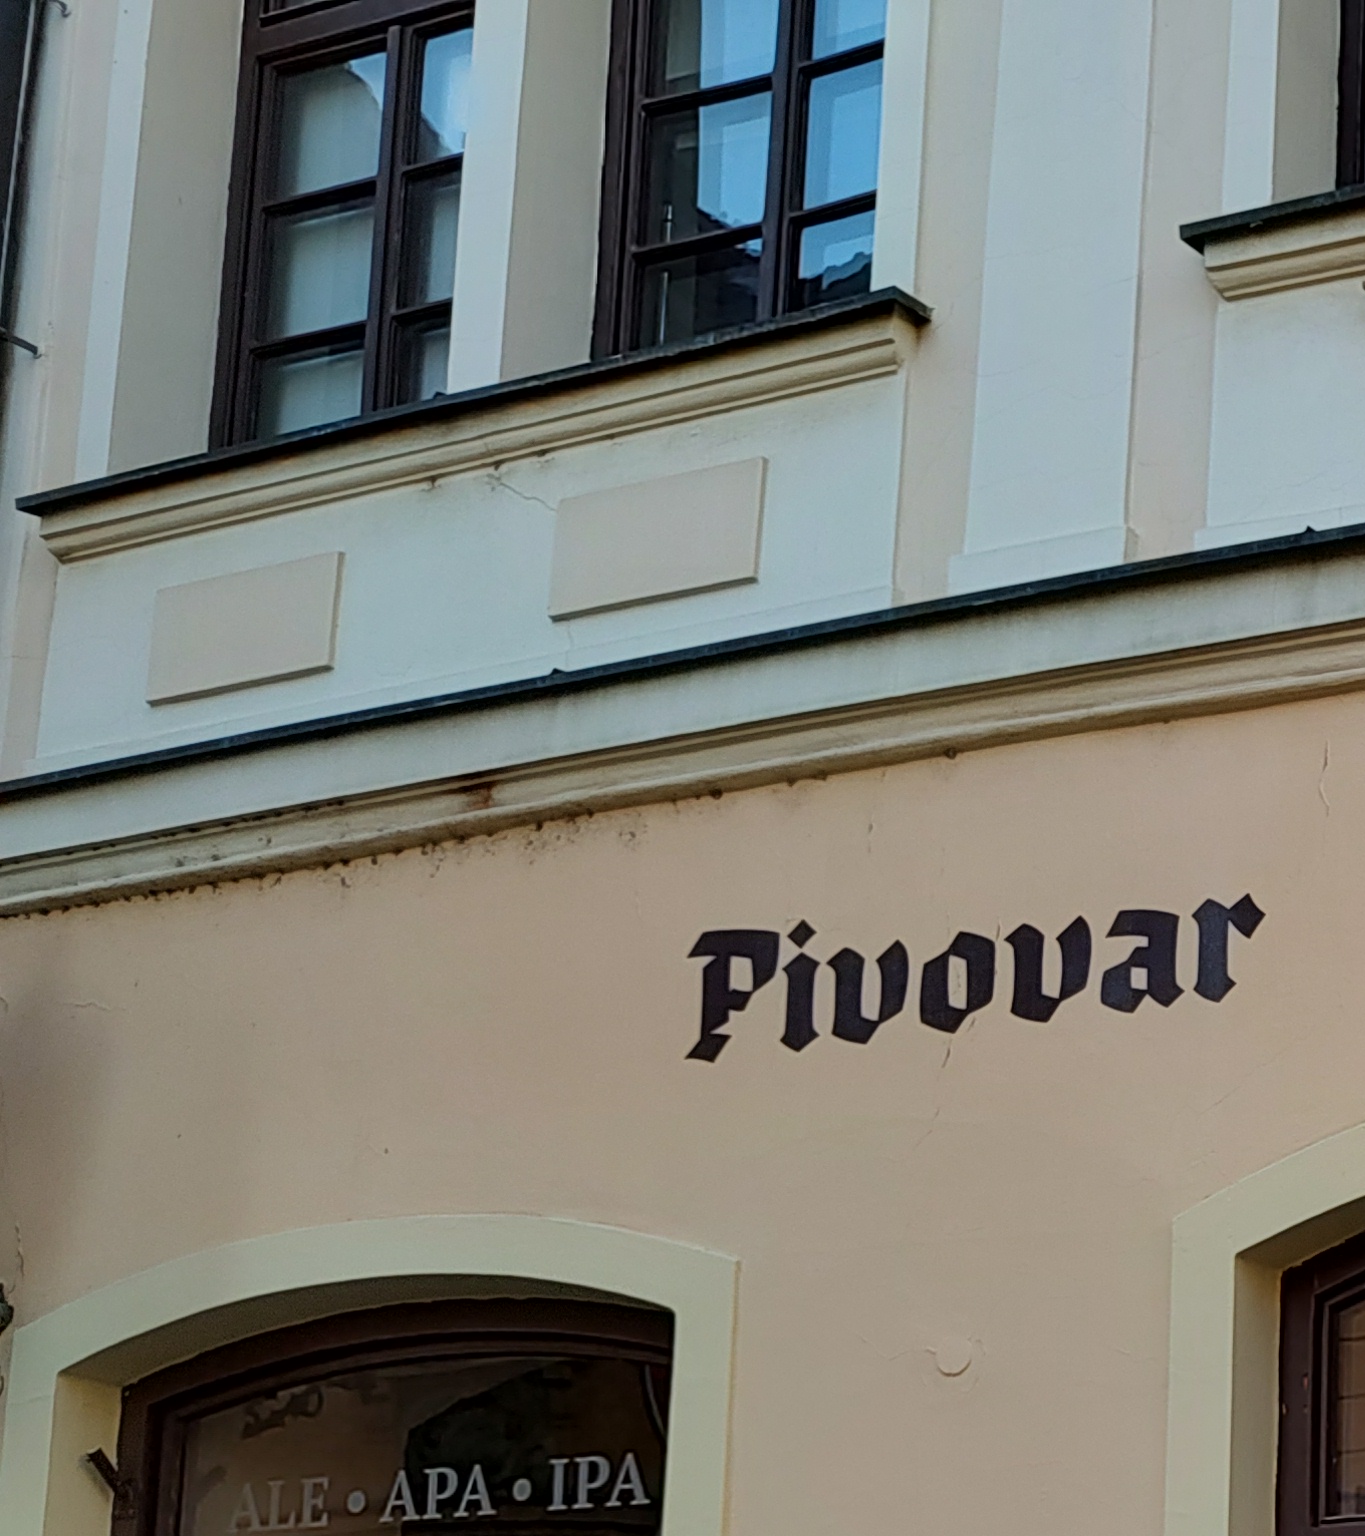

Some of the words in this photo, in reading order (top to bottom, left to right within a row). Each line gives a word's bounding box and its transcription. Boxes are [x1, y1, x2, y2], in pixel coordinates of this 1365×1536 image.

[685, 893, 1266, 1063] Pivovar
[227, 1476, 330, 1534] ALE
[378, 1463, 497, 1524] APA
[545, 1451, 652, 1512] IPA
